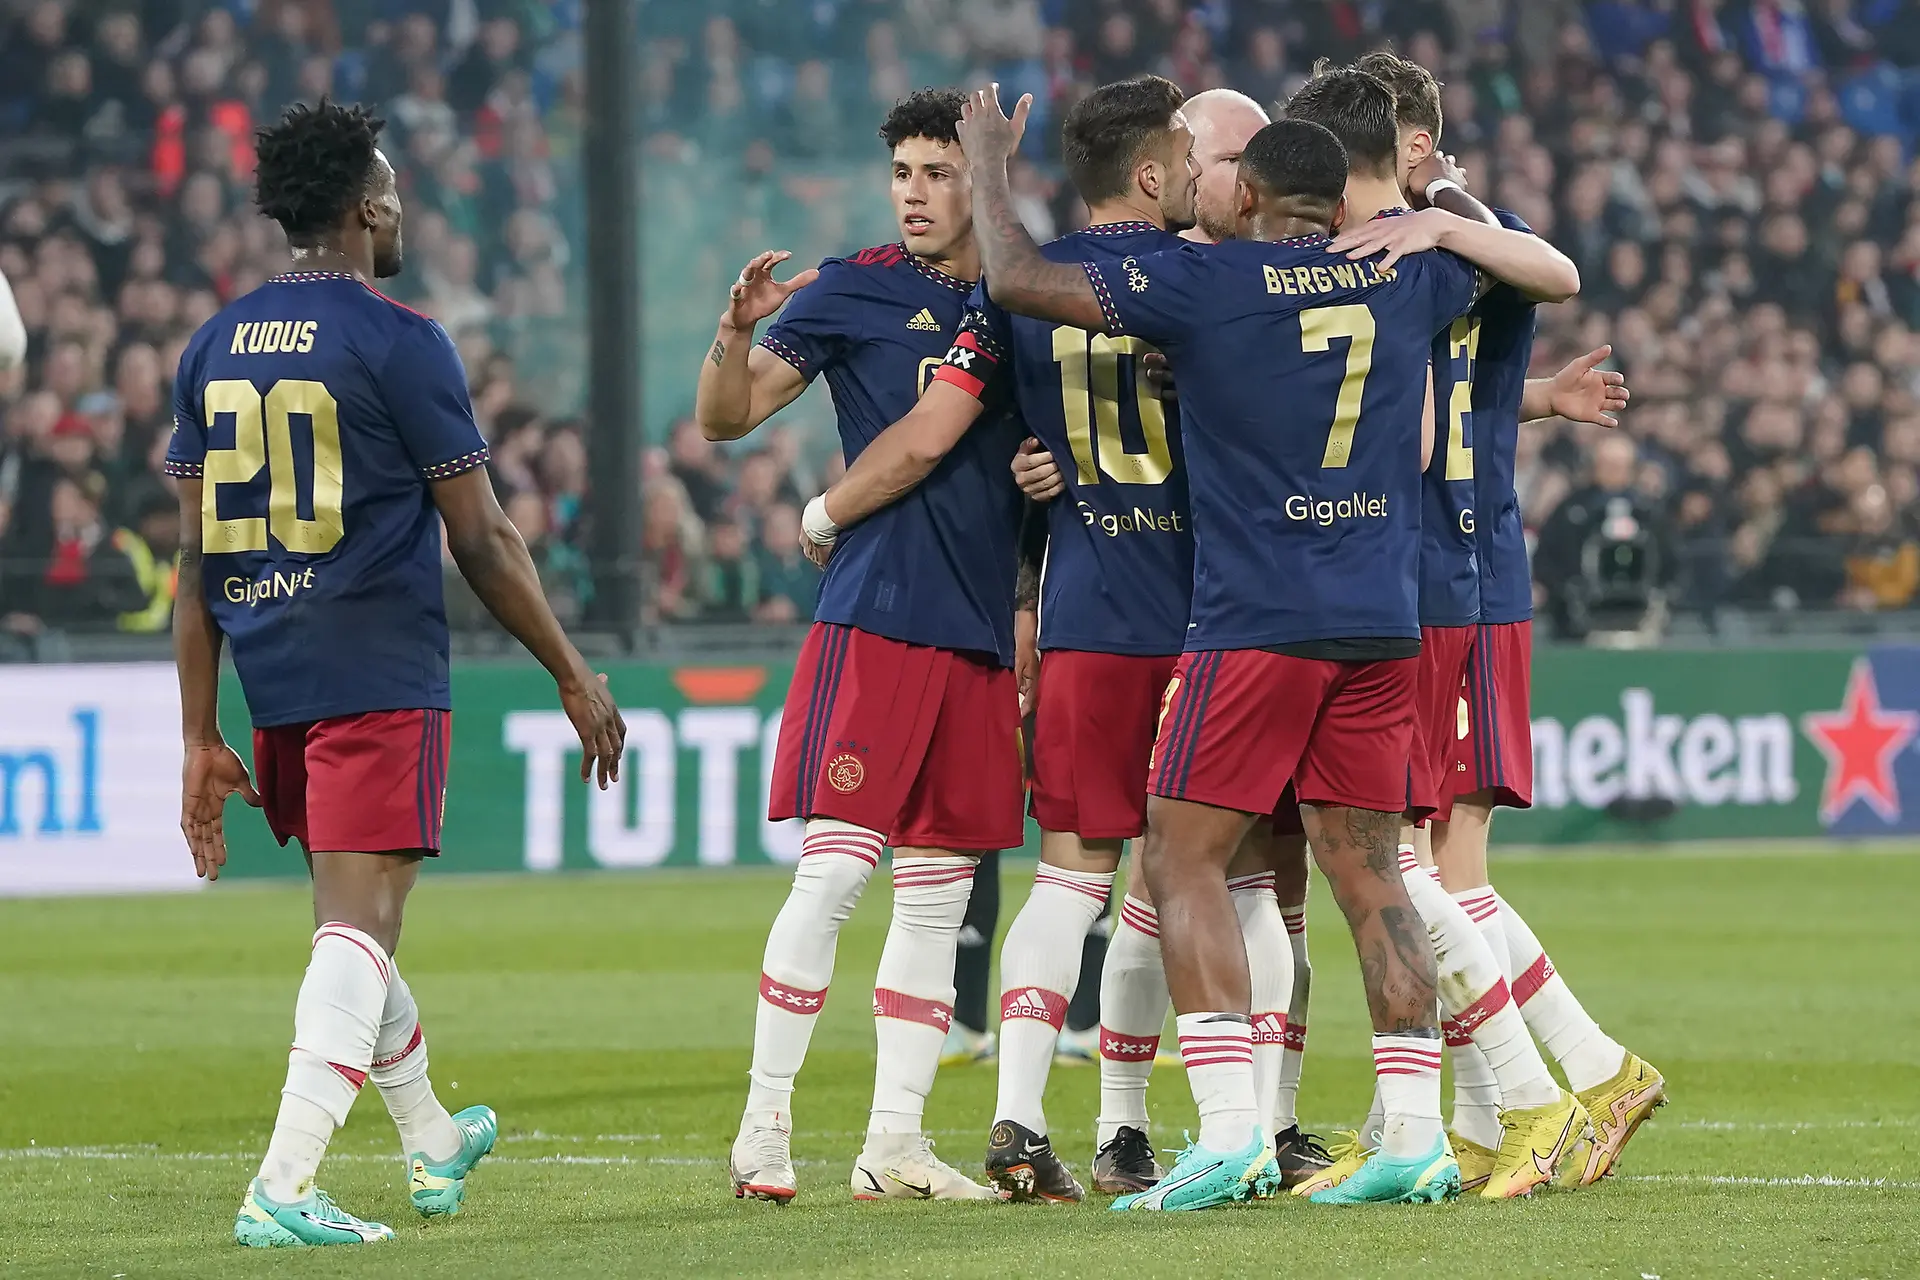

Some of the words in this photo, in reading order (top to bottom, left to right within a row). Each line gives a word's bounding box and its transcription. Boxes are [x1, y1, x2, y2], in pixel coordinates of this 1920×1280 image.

[230, 320, 318, 354] KUDUS
[905, 321, 941, 332] adidas
[1299, 303, 1376, 468] 7
[1445, 316, 1481, 481] 2
[1052, 324, 1173, 486] 10
[202, 379, 344, 554] 20
[1285, 491, 1388, 526] GigaNet
[829, 753, 850, 769] AJAX
[1531, 687, 1800, 810] neken
[1004, 1006, 1051, 1021] adidas
[1251, 1028, 1285, 1043] didas
